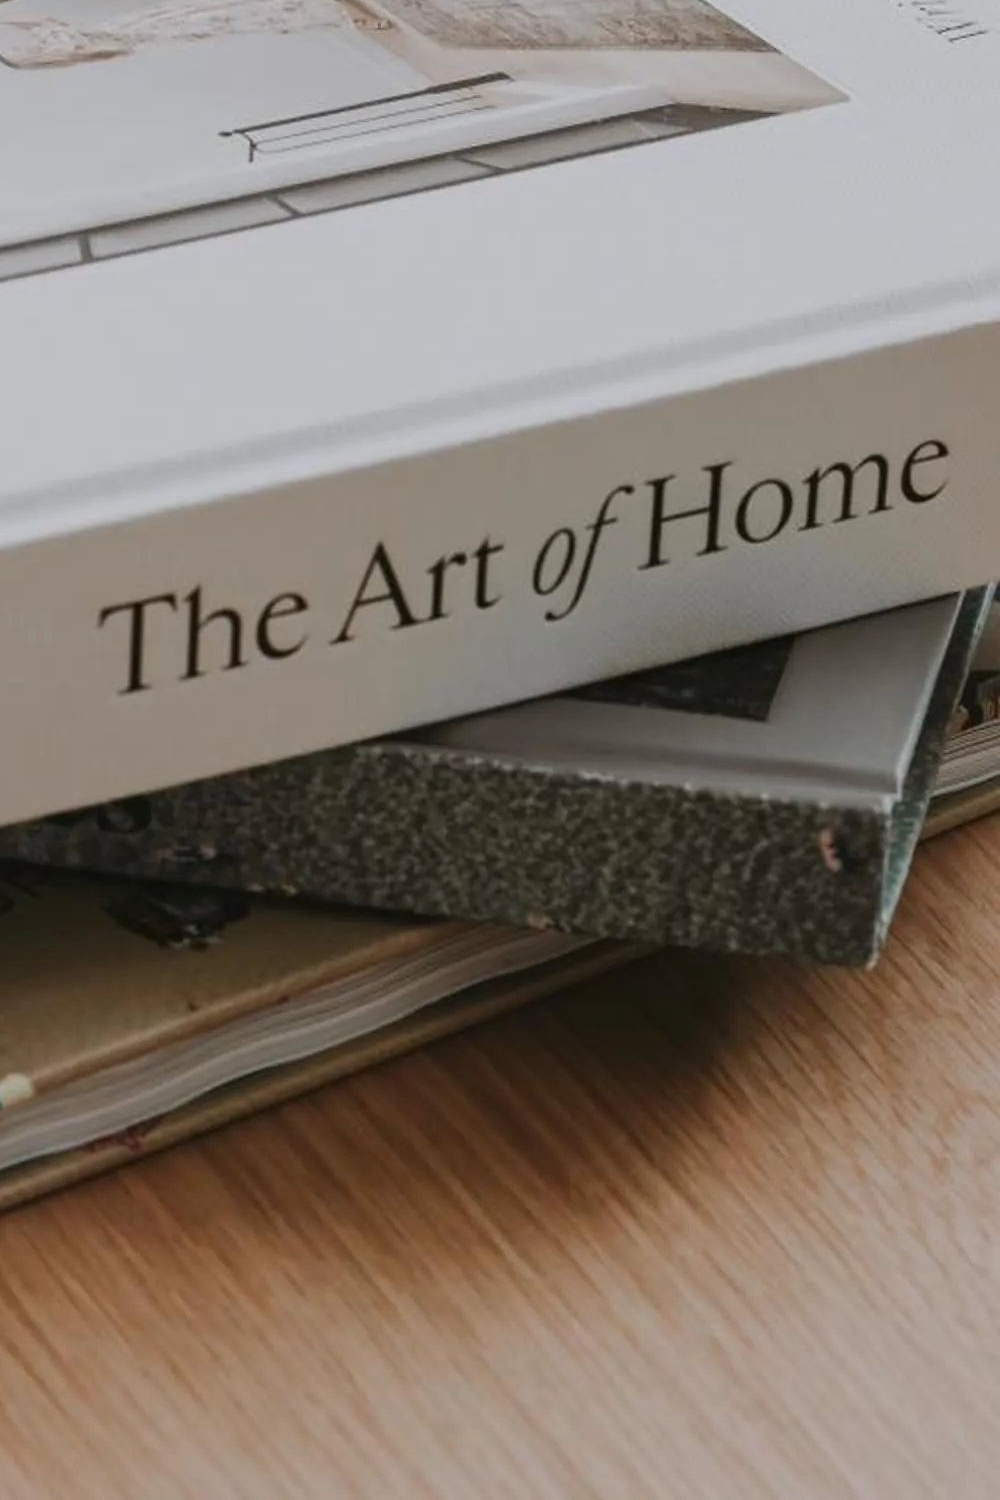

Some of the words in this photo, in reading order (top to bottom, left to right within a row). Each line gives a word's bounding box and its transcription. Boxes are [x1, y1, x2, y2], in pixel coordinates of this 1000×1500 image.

[97, 583, 311, 695] The
[329, 541, 505, 646] Art
[531, 484, 634, 622] of
[637, 437, 950, 571] Home
